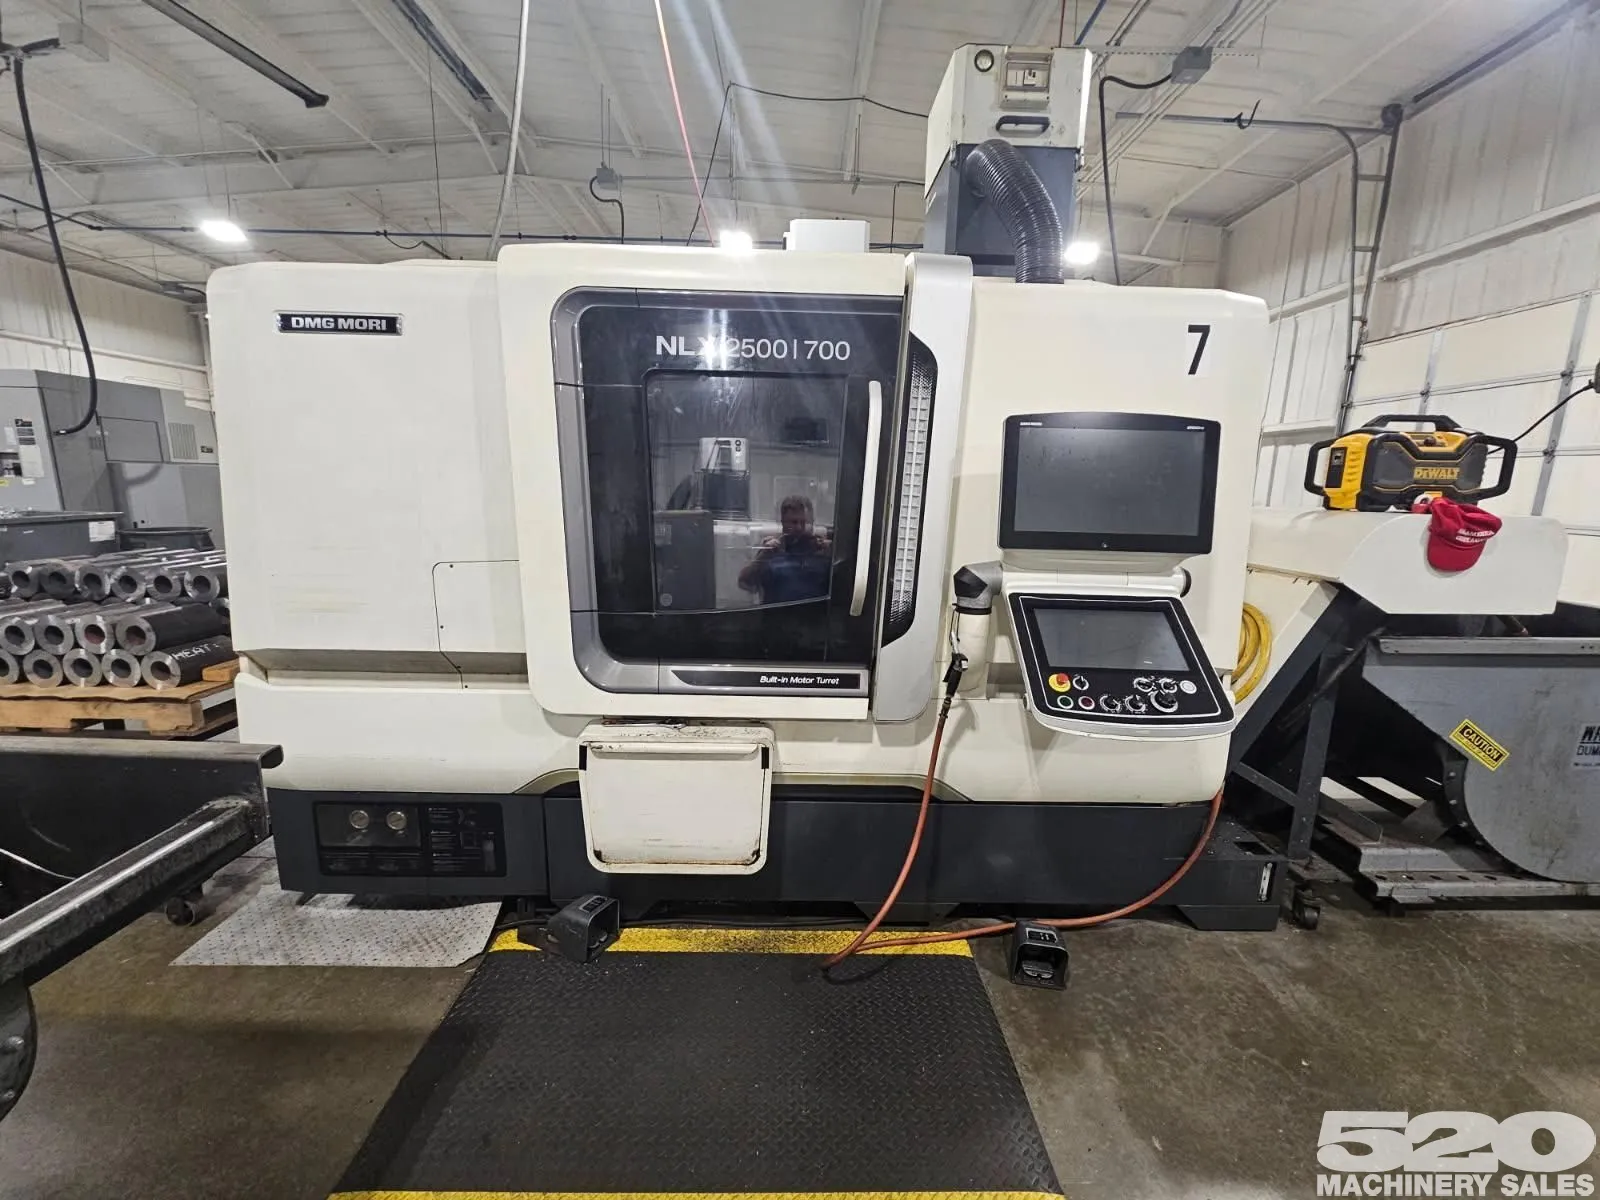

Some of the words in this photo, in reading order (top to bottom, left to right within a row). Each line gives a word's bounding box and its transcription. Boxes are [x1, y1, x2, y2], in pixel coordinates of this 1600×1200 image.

[291, 316, 335, 329] DMG
[337, 317, 388, 331] MORI
[1187, 324, 1211, 376] 7
[759, 674, 789, 684] Built-in
[790, 676, 815, 685] Motor
[816, 676, 840, 686] Turret
[1462, 728, 1501, 760] CAUTION
